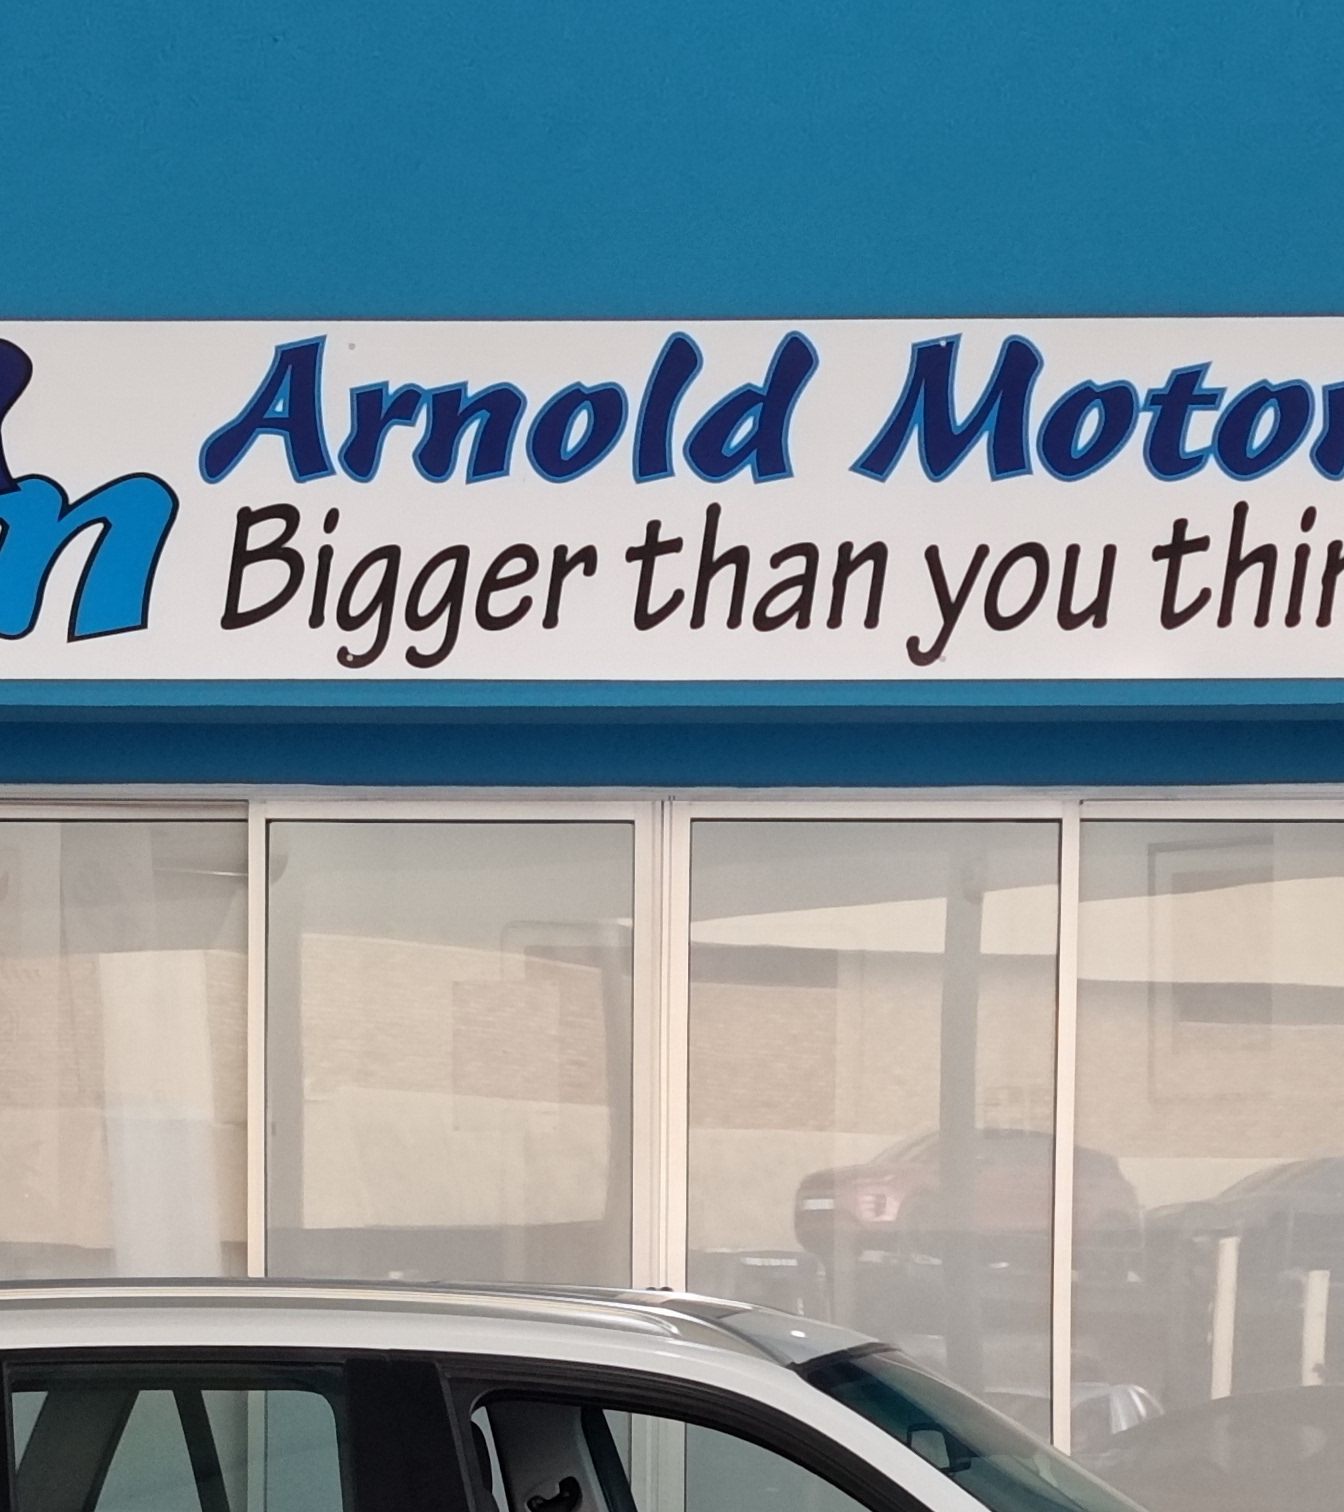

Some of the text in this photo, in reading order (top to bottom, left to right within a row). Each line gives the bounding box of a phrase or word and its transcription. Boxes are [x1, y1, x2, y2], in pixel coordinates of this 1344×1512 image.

[198, 330, 820, 485] Arnold
[219, 503, 598, 670] Bigger
[625, 502, 890, 633] than
[905, 541, 1118, 668] you
